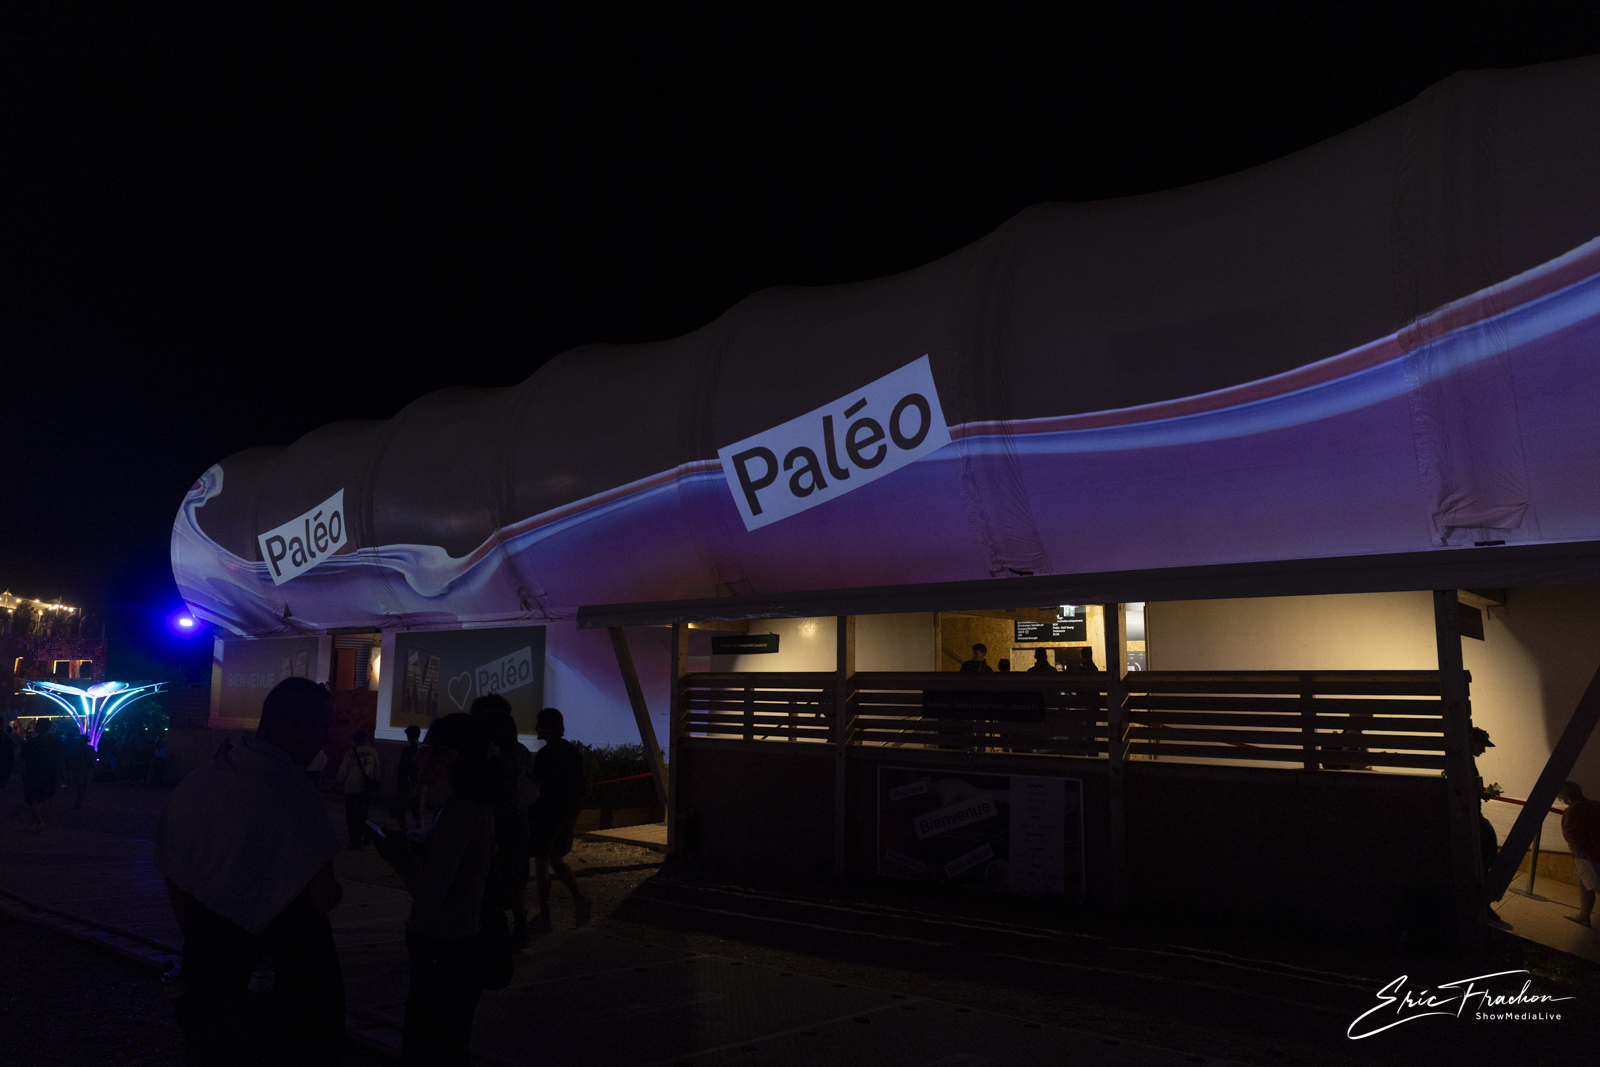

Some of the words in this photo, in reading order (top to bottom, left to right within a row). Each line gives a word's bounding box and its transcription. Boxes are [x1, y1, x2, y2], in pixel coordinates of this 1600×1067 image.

[732, 393, 931, 516] Paléo
[265, 510, 341, 577] Paléo
[227, 672, 275, 688] BIENVENUE
[479, 657, 530, 697] Paléo
[892, 785, 924, 798] Welcome
[920, 802, 990, 834] Bienvenue
[947, 849, 990, 874] Benvenuto
